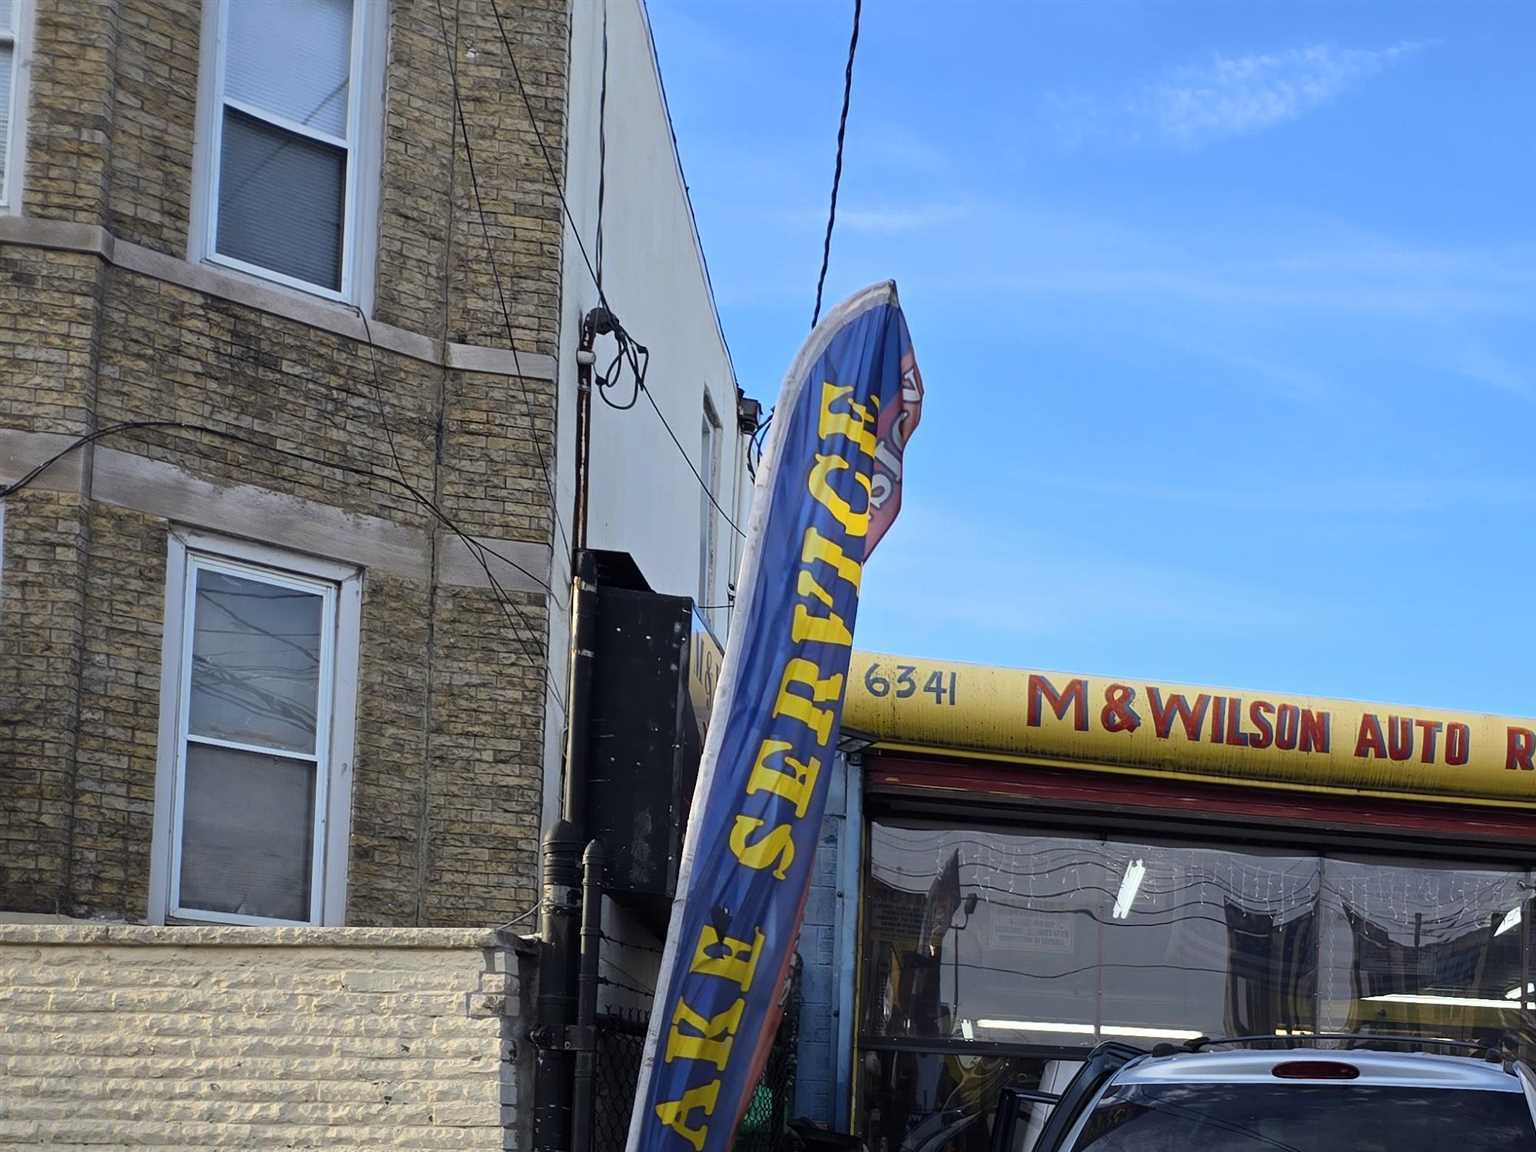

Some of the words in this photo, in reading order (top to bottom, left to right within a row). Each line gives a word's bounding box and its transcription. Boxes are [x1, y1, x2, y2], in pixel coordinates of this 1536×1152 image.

[728, 381, 882, 881] SERVICE
[863, 662, 957, 706] 6341
[1353, 712, 1471, 766] AUTO
